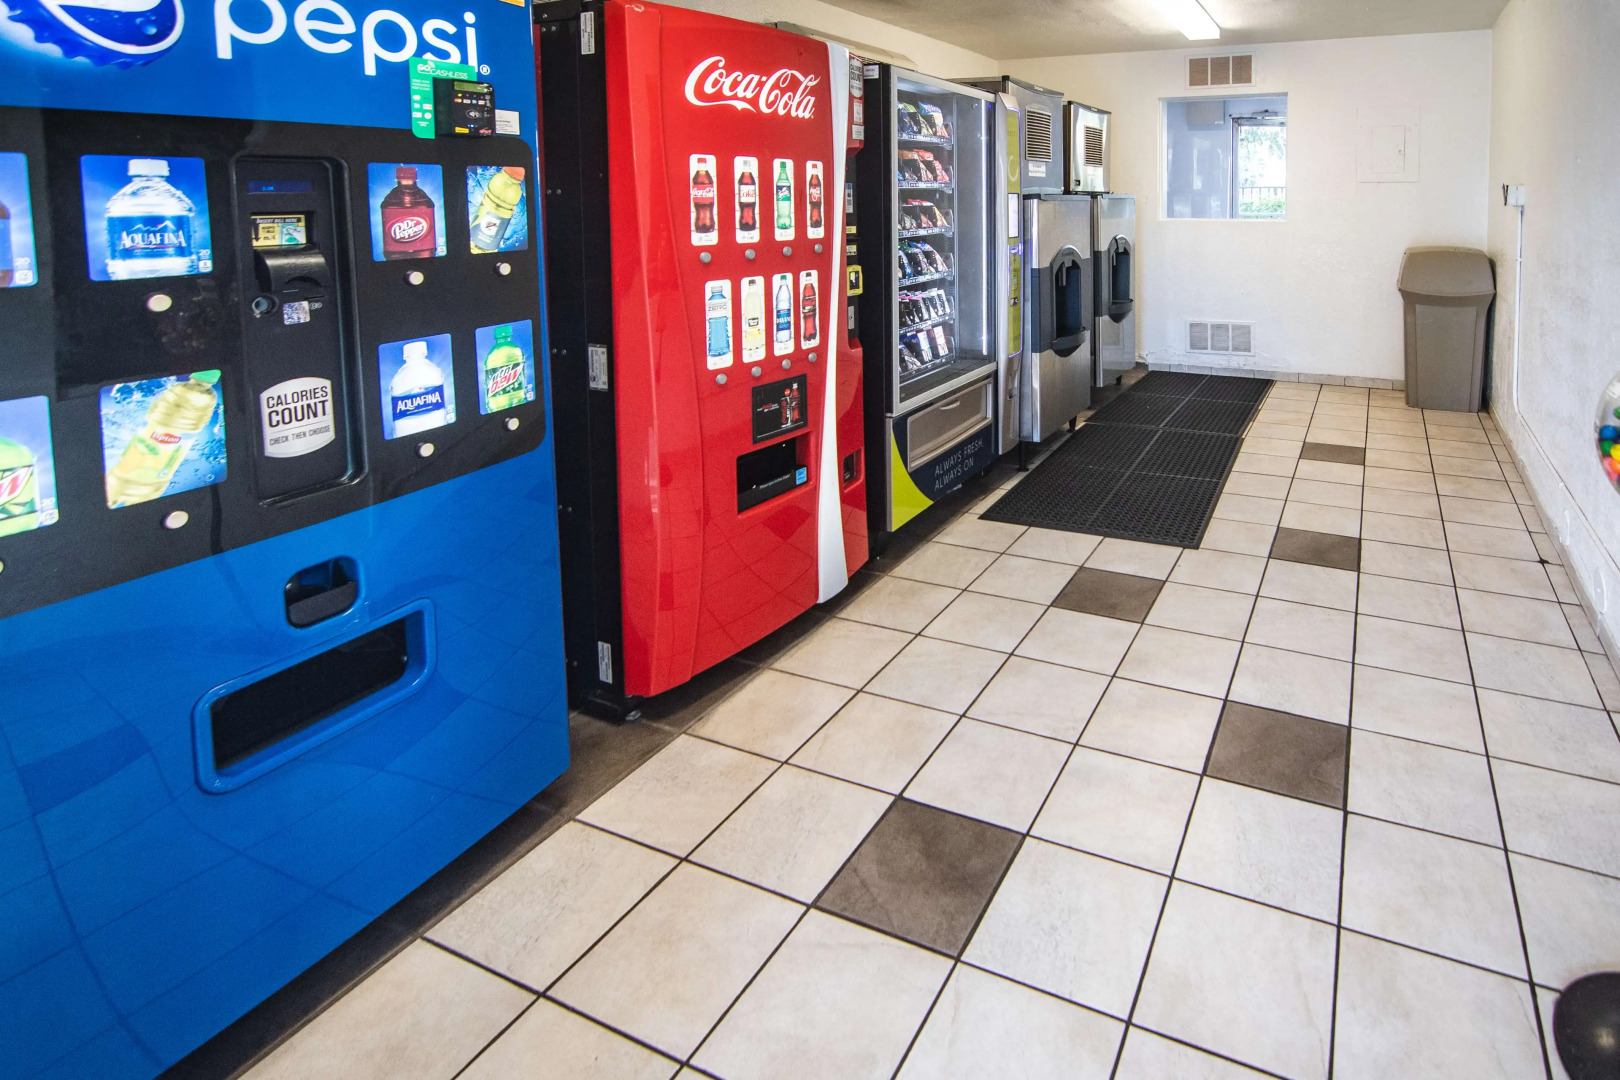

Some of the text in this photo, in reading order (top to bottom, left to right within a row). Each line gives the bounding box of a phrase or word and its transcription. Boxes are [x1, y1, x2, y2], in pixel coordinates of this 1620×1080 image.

[430, 67, 469, 79] CASHLESS
[685, 56, 821, 119] Coca-Cola
[119, 230, 187, 249] AQUAFINA
[395, 222, 425, 240] Pepper
[266, 385, 329, 409] CALORIES
[397, 391, 442, 413] AQUAFINA
[268, 399, 329, 428] COUNT
[269, 425, 331, 447] CHECK THEN CHOOSE
[935, 450, 962, 477] ALWAYS
[935, 457, 974, 491] ALWAYS ON
